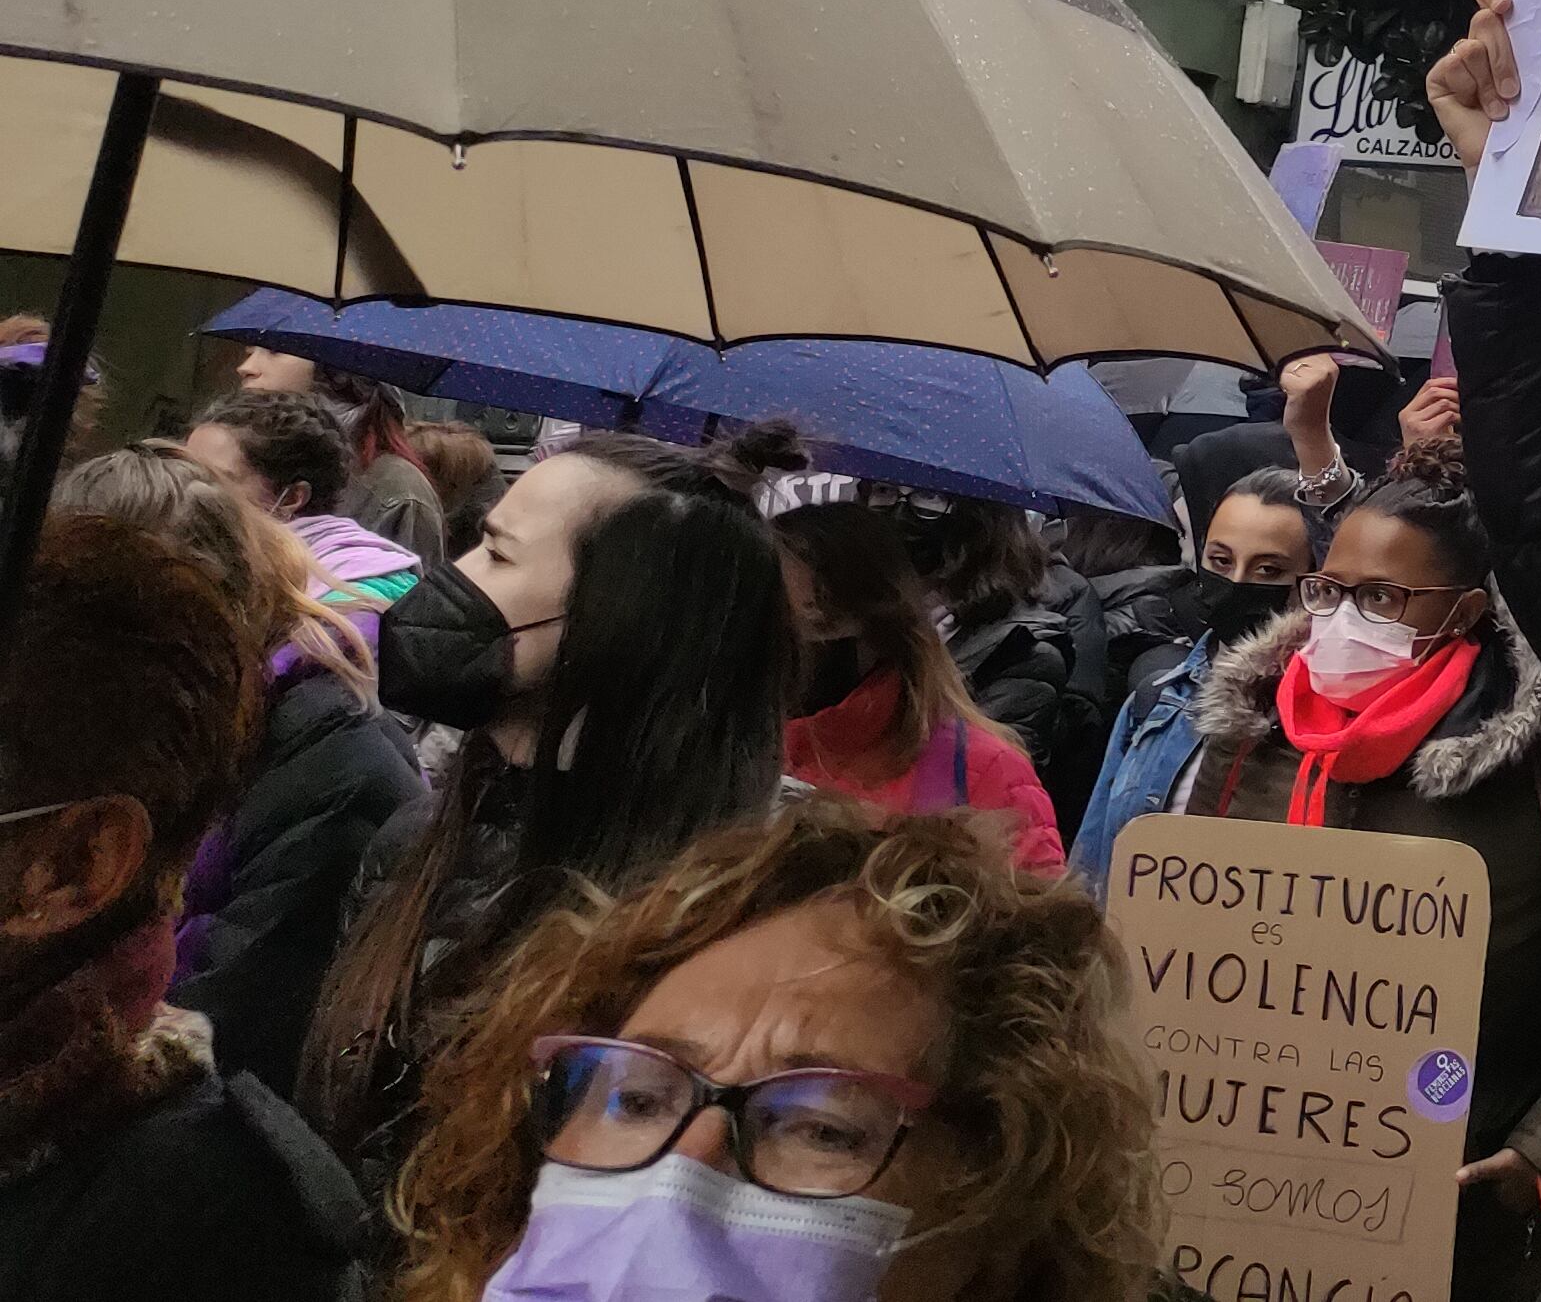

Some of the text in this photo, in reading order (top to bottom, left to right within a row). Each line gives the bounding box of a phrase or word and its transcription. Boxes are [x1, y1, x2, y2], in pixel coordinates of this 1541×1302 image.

[1127, 852, 1469, 940] PROSTITUCIÓN
[1251, 921, 1284, 946] es
[1140, 945, 1439, 1036] VIOLENCIA
[1144, 1024, 1385, 1083] CONTRA LAS
